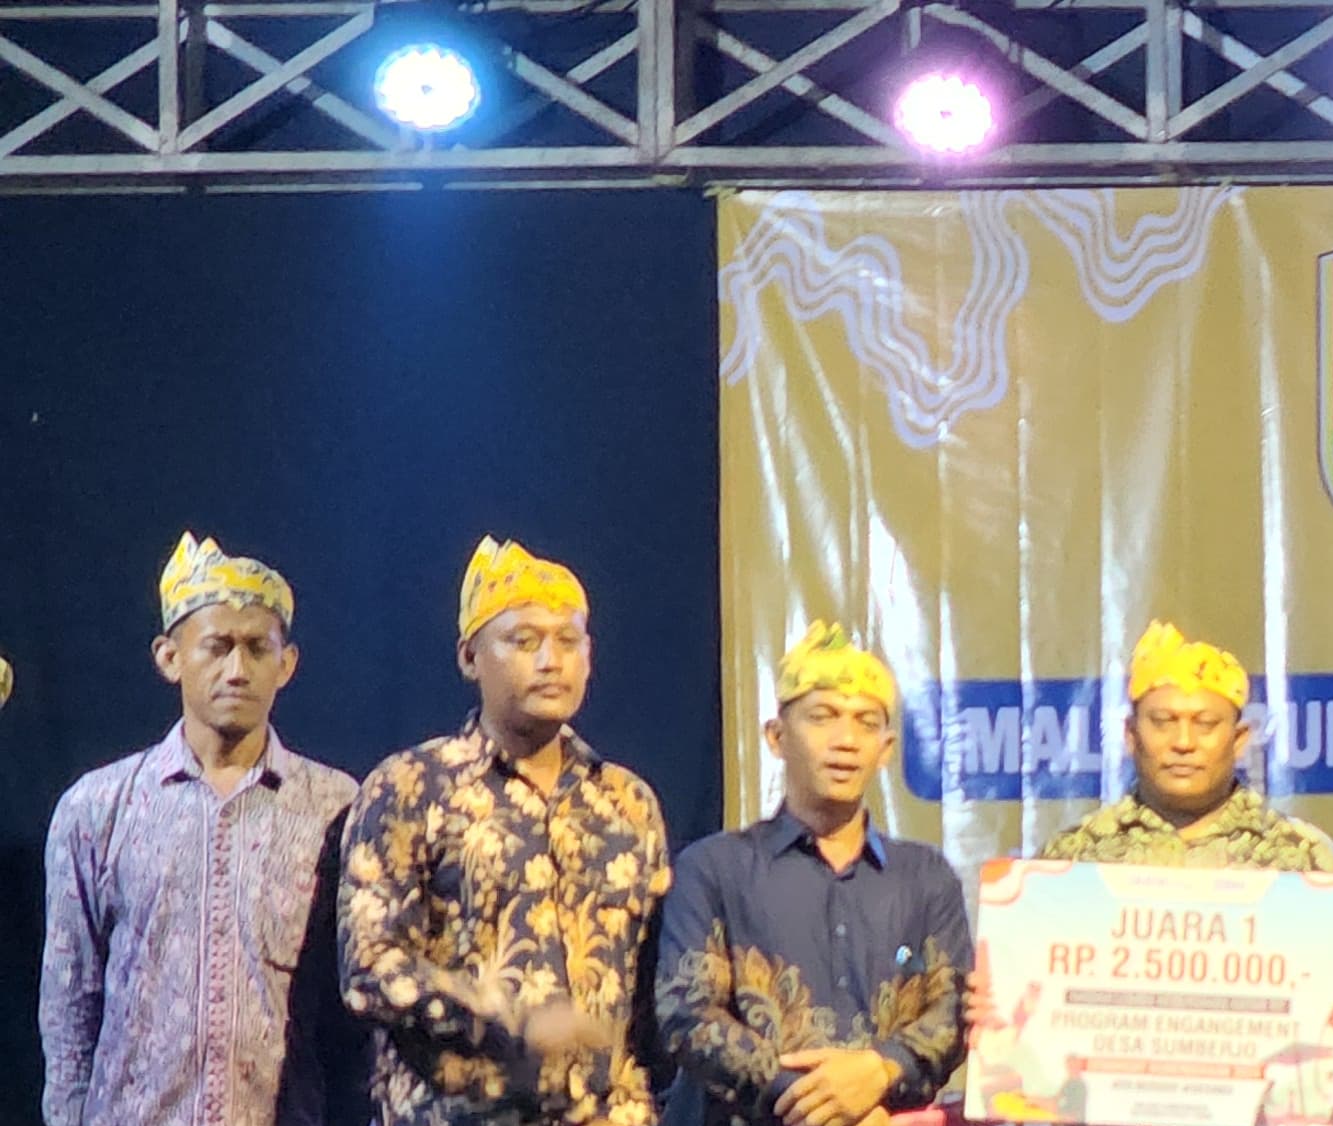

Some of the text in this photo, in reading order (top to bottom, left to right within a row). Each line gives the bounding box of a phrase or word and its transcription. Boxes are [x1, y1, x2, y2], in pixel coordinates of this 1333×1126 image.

[965, 704, 1106, 776] MAL
[1111, 907, 1257, 945] JUARA 1
[1048, 944, 1310, 988] RP. 2.500.000,-
[1050, 1011, 1300, 1039] PROGRAM ENGANGEMENT
[1093, 1033, 1257, 1058] DESA SUMBERJO
